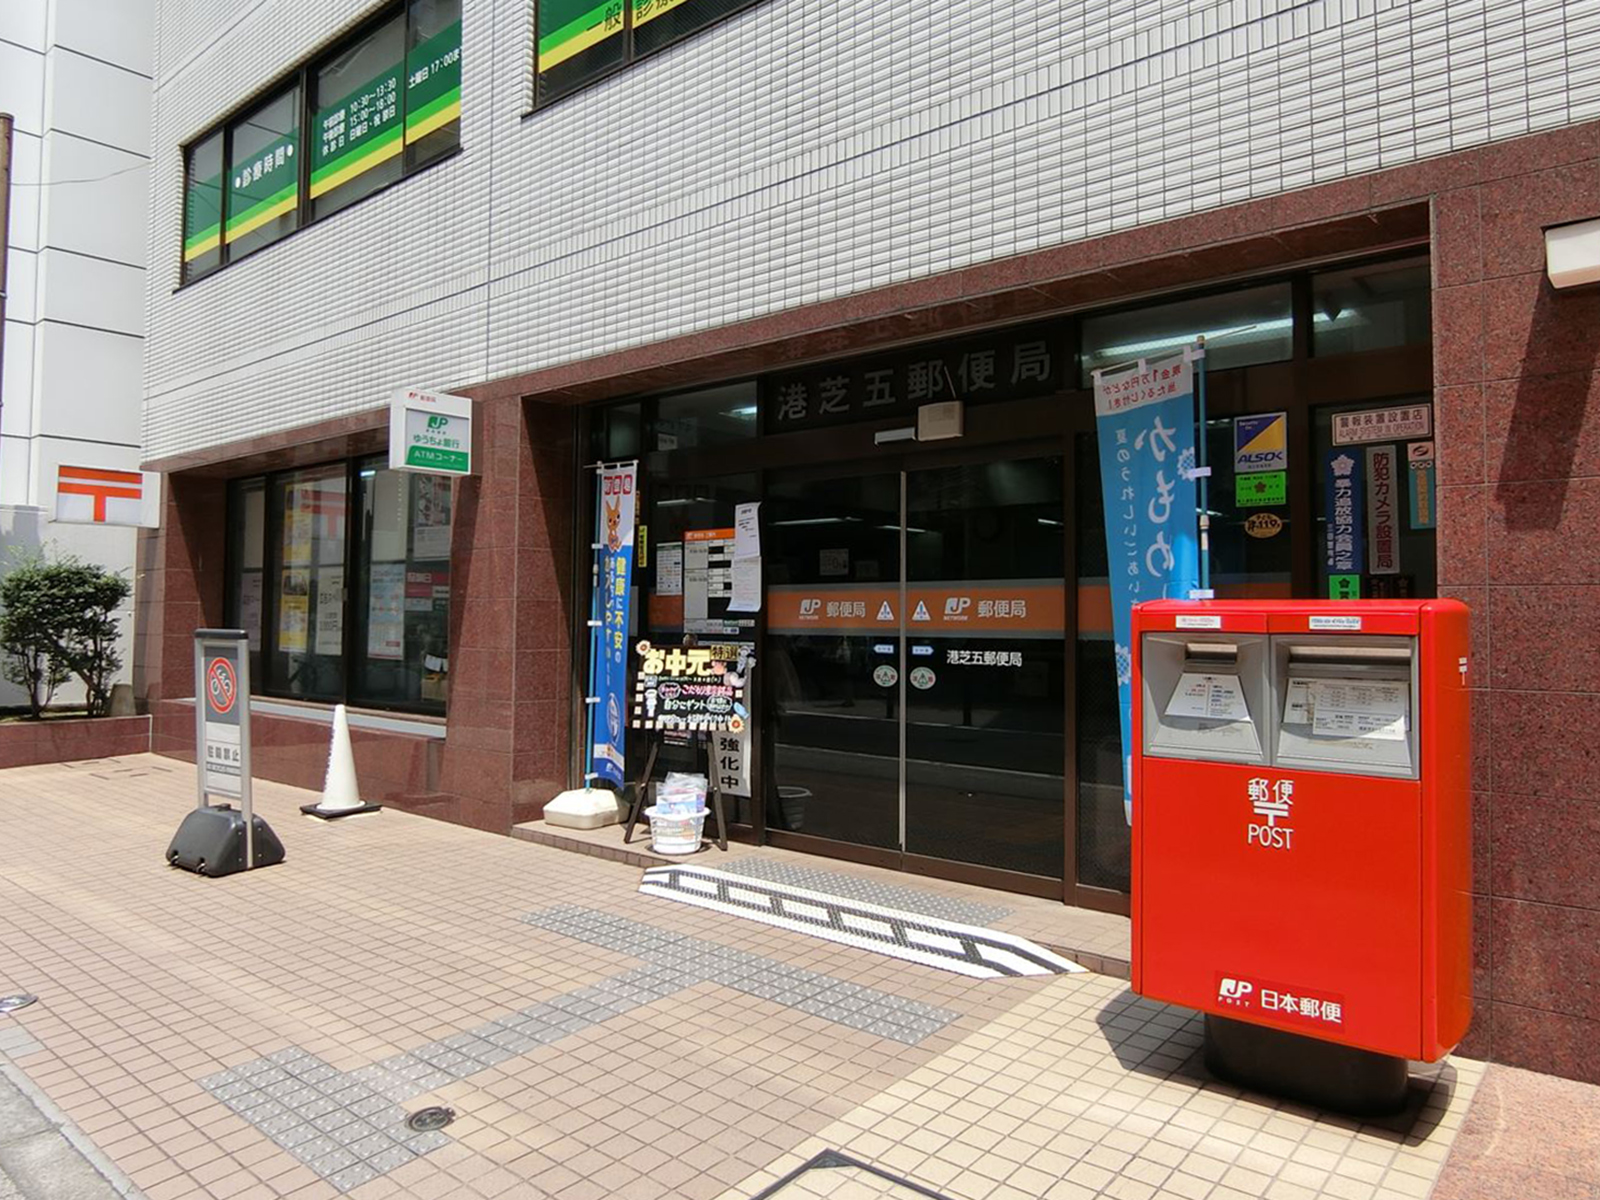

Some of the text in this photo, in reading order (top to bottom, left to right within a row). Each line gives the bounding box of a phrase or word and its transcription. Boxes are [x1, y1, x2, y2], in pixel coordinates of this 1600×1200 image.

[408, 47, 462, 89] 土曜日 17:00ま
[777, 340, 1051, 421] 港芝五郵便局
[427, 415, 449, 430] JP
[1340, 408, 1423, 429] 警報装置設置店
[413, 434, 459, 449] ゆうちょ銀行
[413, 450, 464, 462] ATMコーナー
[1237, 451, 1283, 464] ALSOK
[1373, 452, 1393, 570] 防犯カメラ設置局
[800, 598, 821, 615] JP
[826, 601, 866, 618] 郵便局
[944, 597, 971, 615] JP
[977, 599, 1026, 618] 郵便局
[643, 648, 711, 676] お中元
[946, 649, 1023, 668] 港芝五郵便局
[720, 737, 740, 789] 強化中
[1247, 777, 1294, 805] 郵便
[1247, 823, 1294, 849] POST
[1219, 977, 1253, 999] JP
[1217, 995, 1250, 1008] POST
[1260, 988, 1342, 1024] 日本郵便
